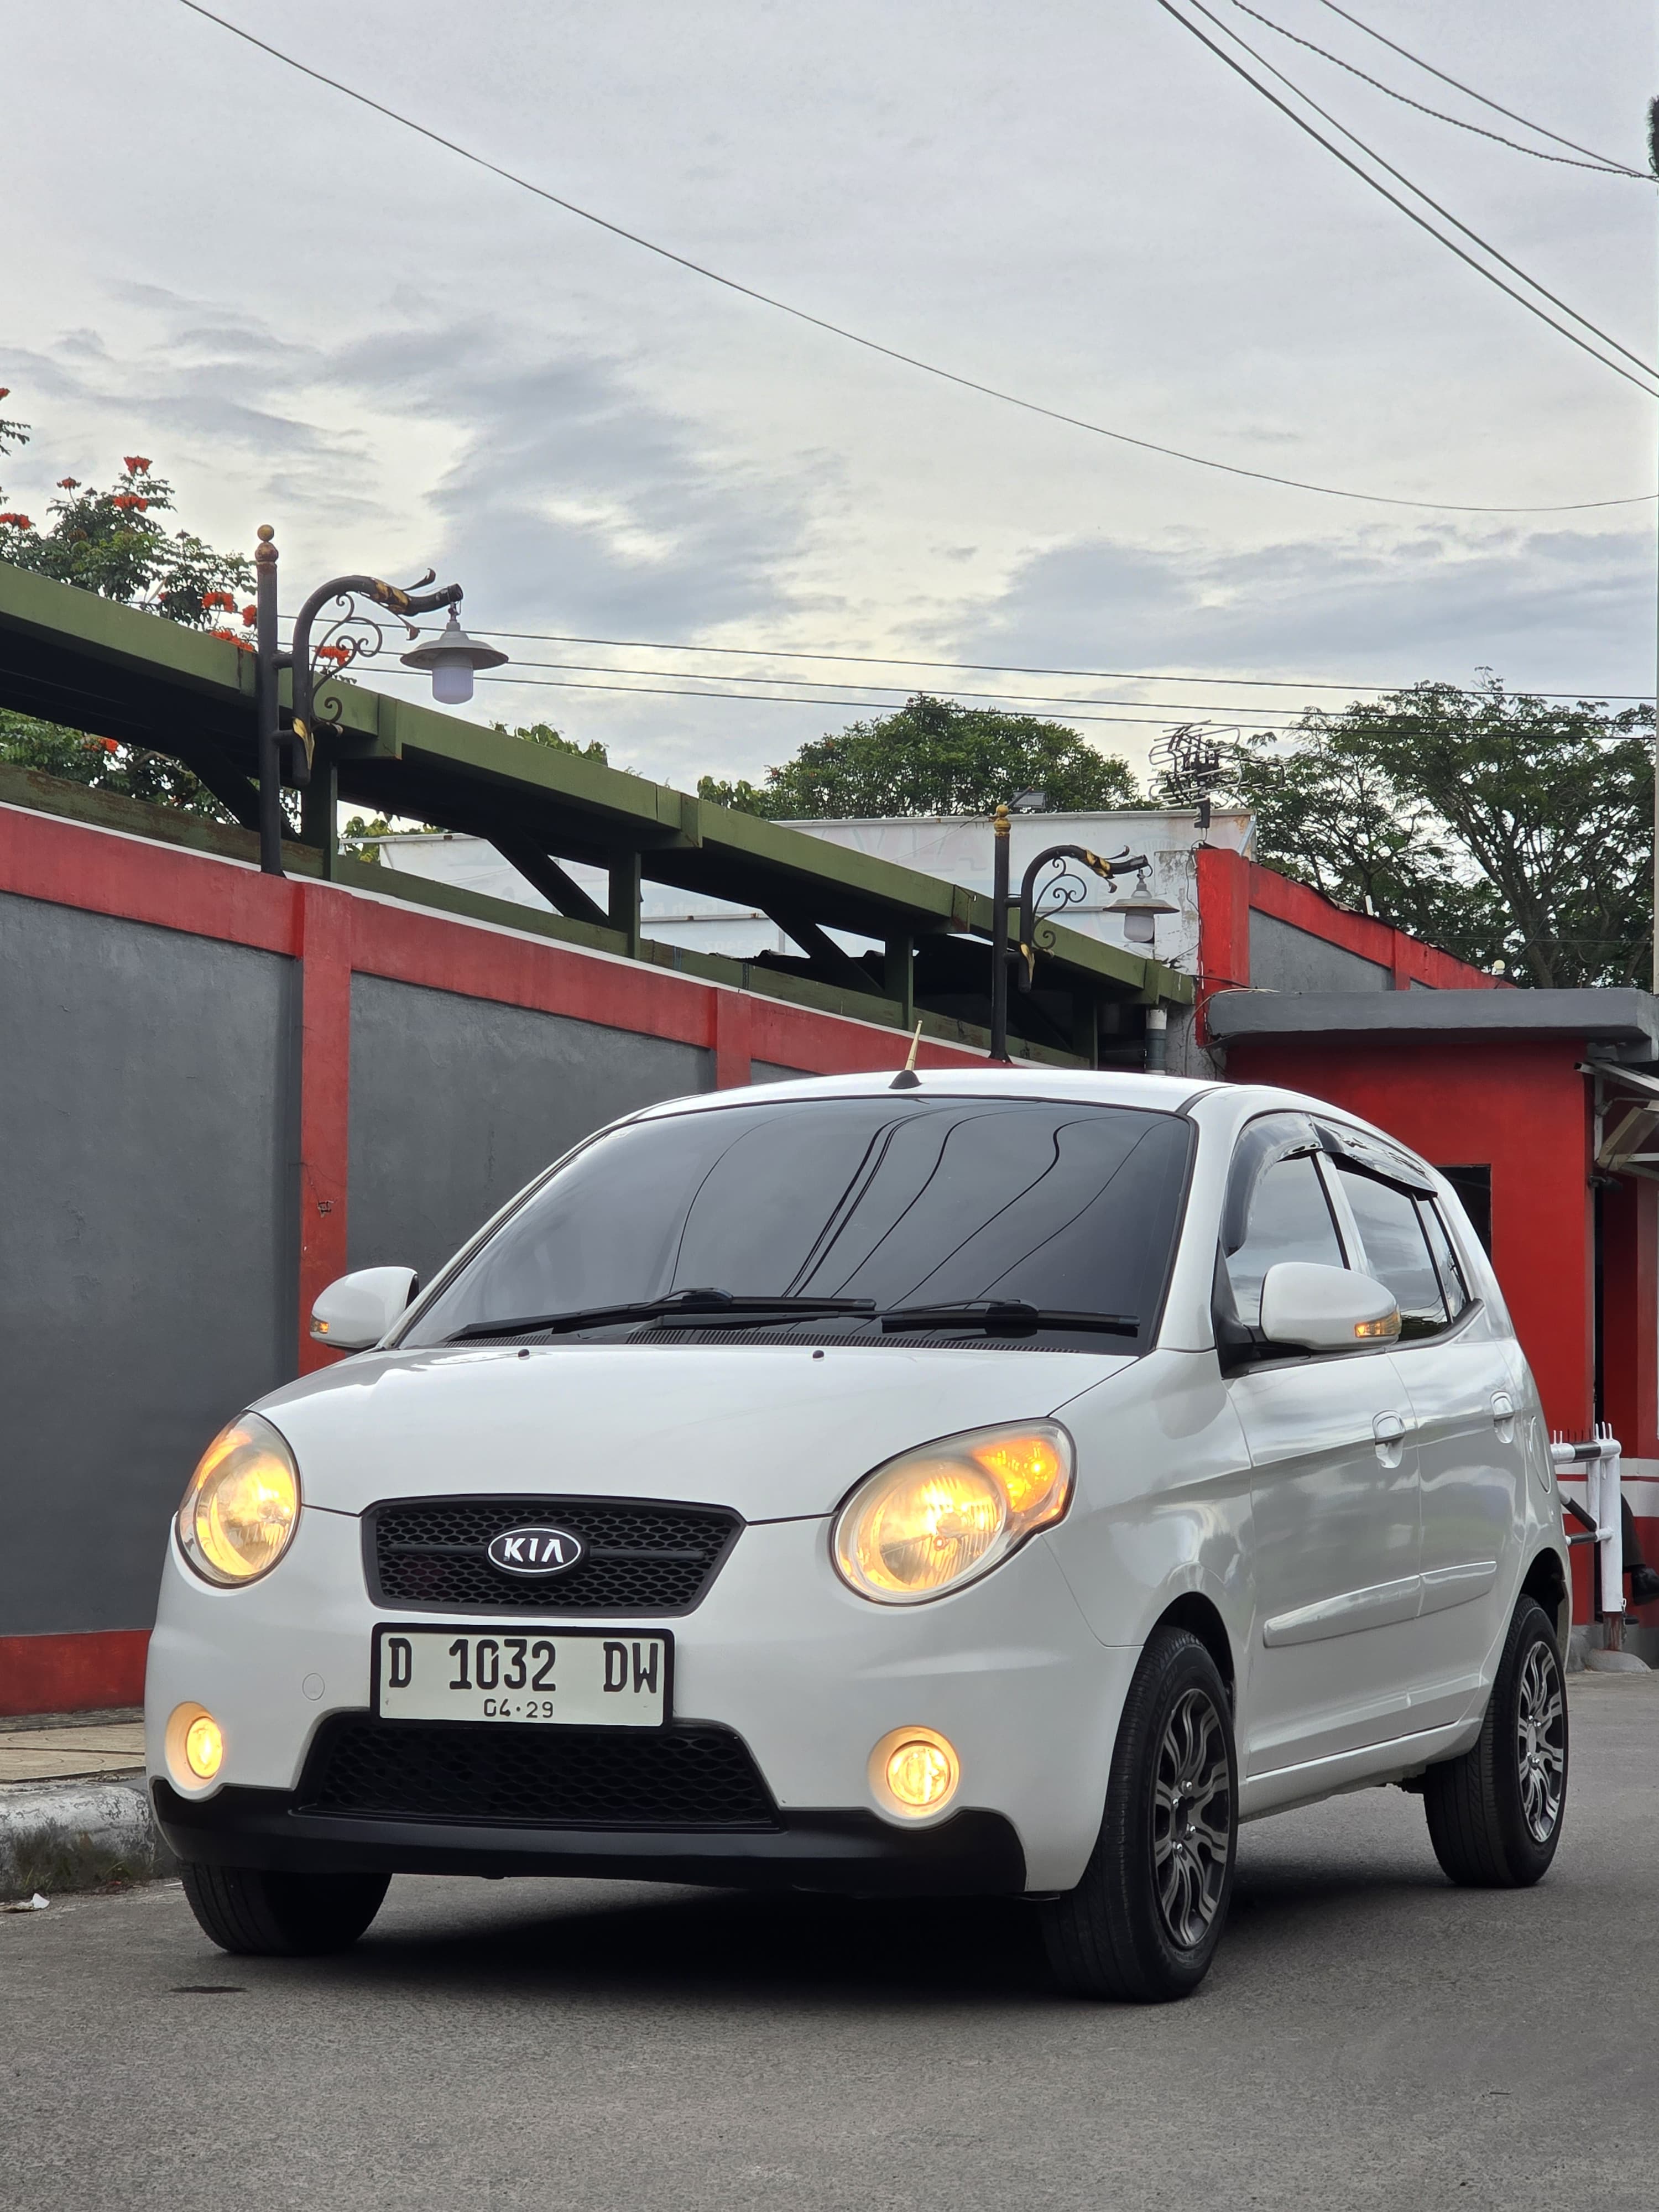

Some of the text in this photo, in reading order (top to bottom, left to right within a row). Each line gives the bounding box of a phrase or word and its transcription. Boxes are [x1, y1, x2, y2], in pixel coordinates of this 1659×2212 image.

[504, 1538, 564, 1563] KIA
[388, 1637, 656, 1693] D 1032 DW
